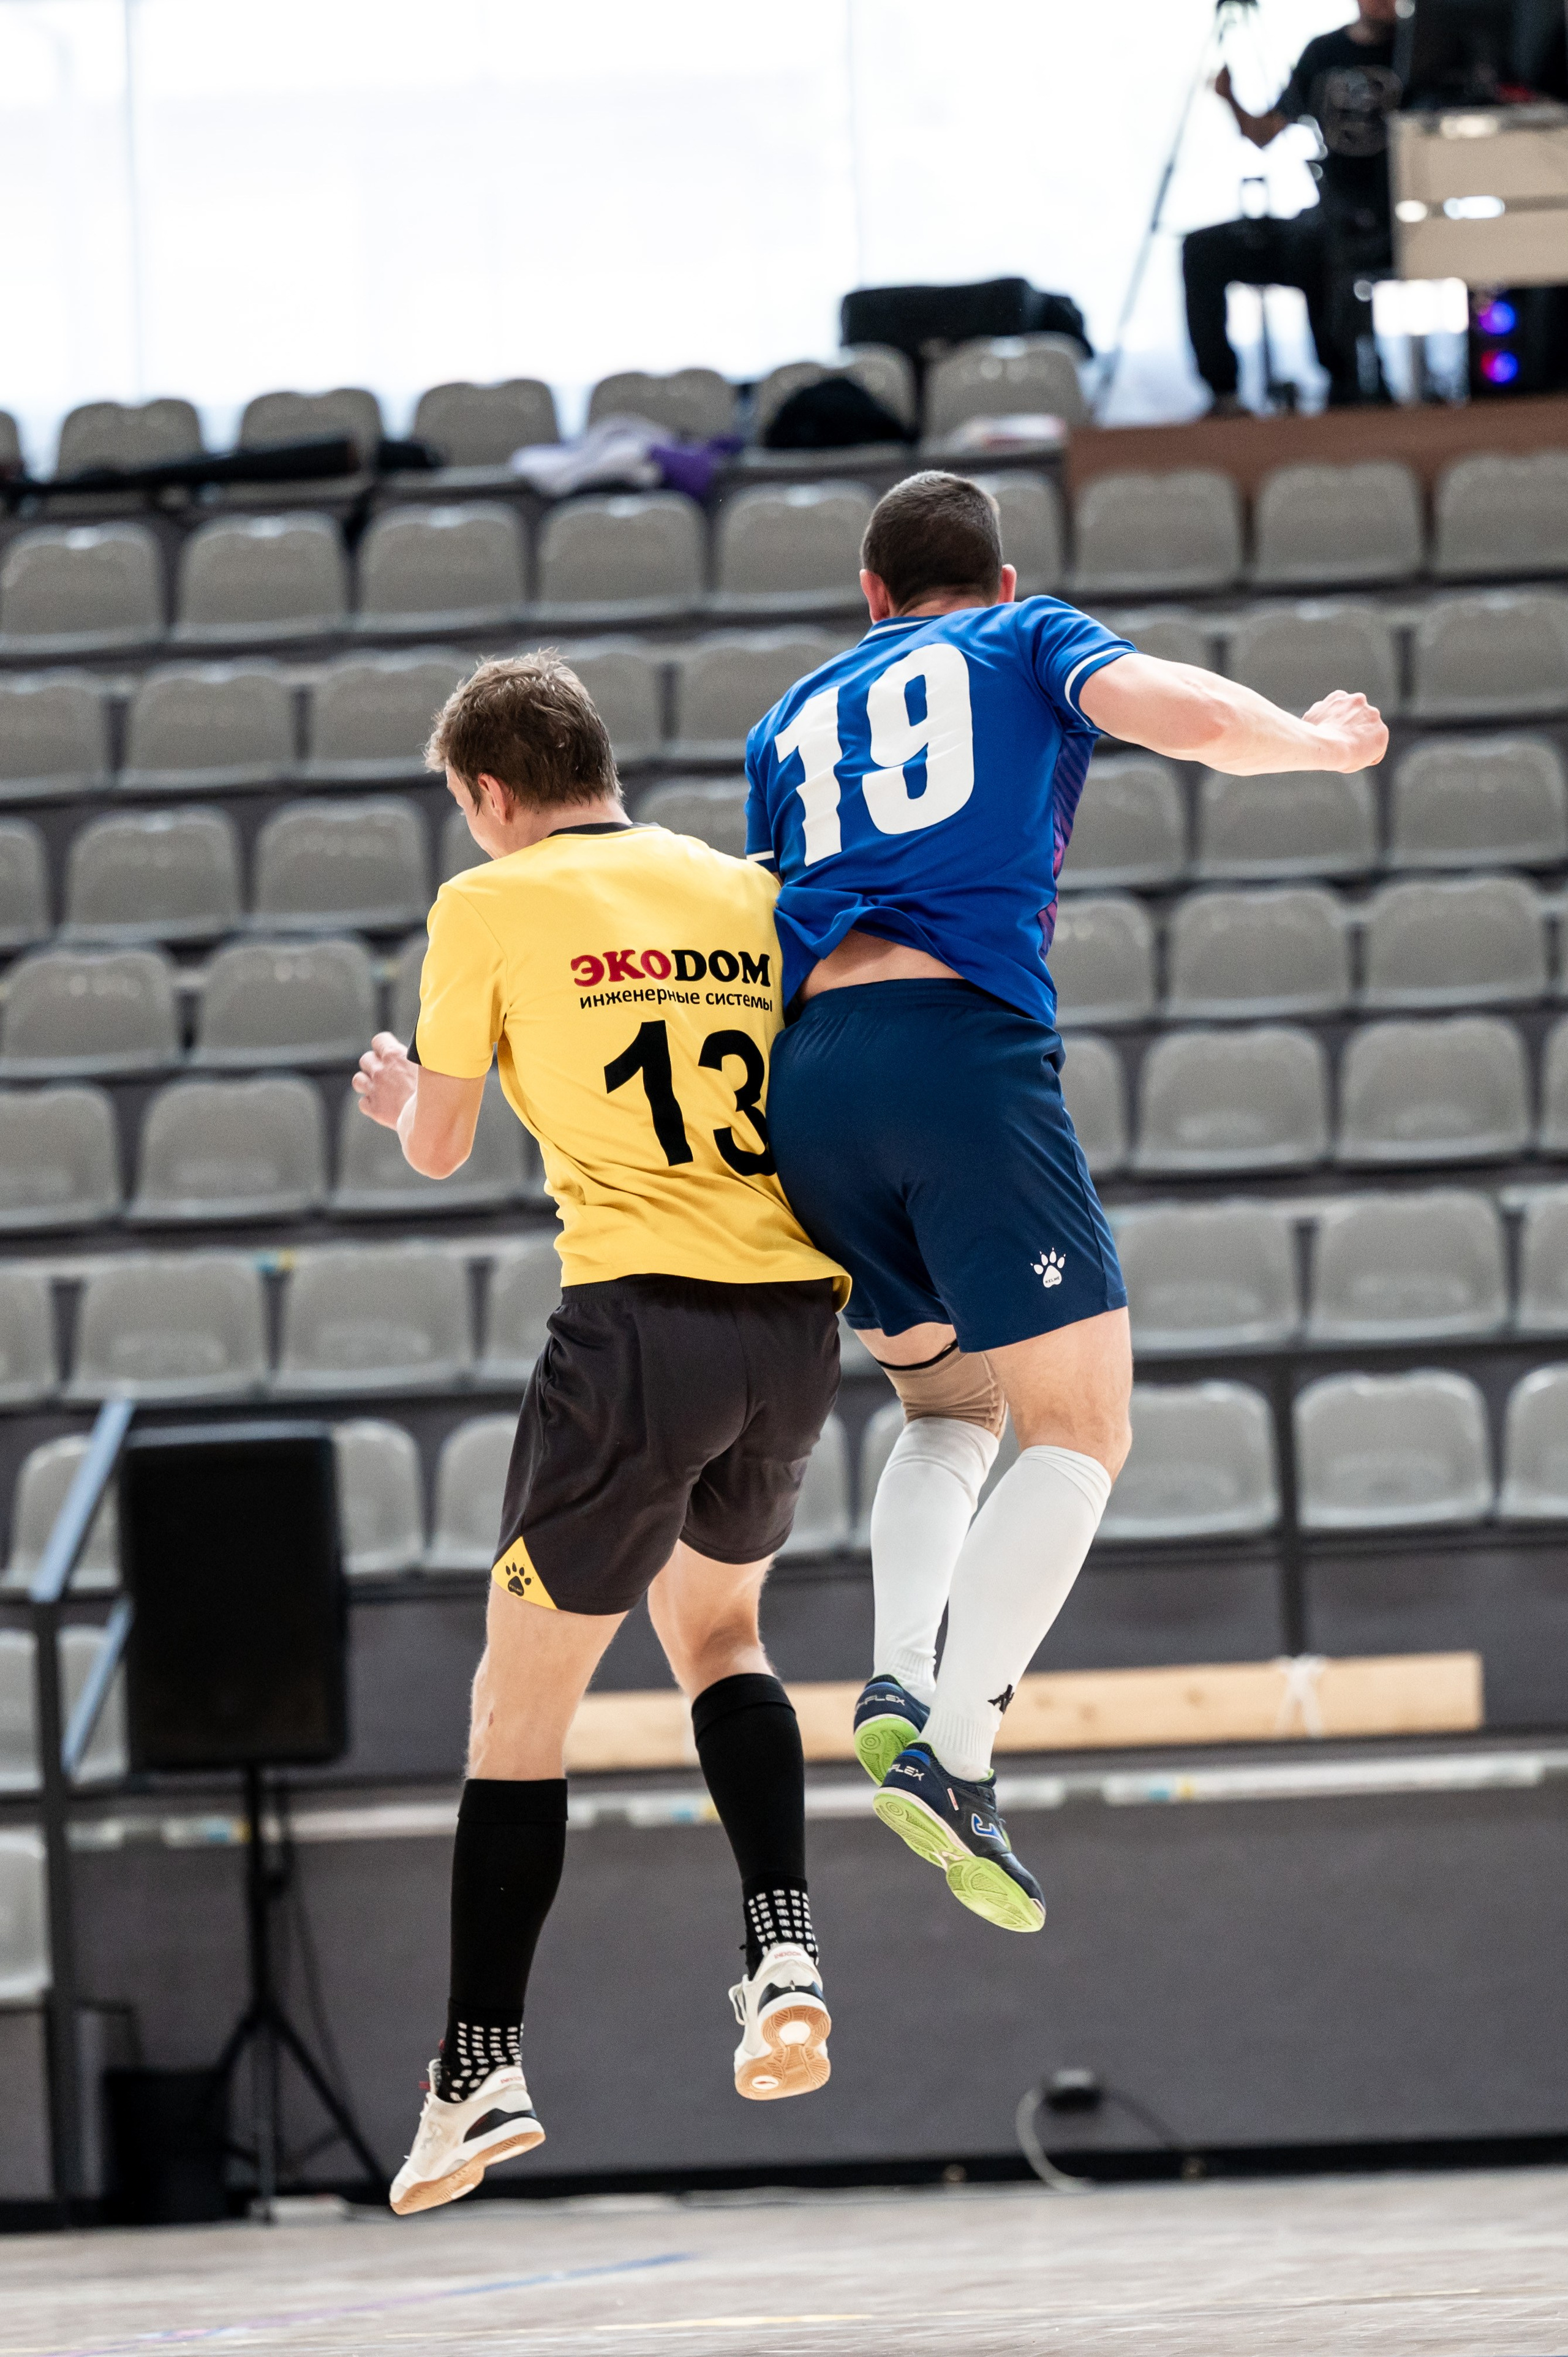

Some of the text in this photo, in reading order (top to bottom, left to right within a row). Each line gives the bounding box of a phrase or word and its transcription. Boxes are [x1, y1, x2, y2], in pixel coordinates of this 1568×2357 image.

[774, 643, 974, 867] 19
[579, 988, 773, 1012] инженерные системы
[603, 1020, 777, 1177] 13
